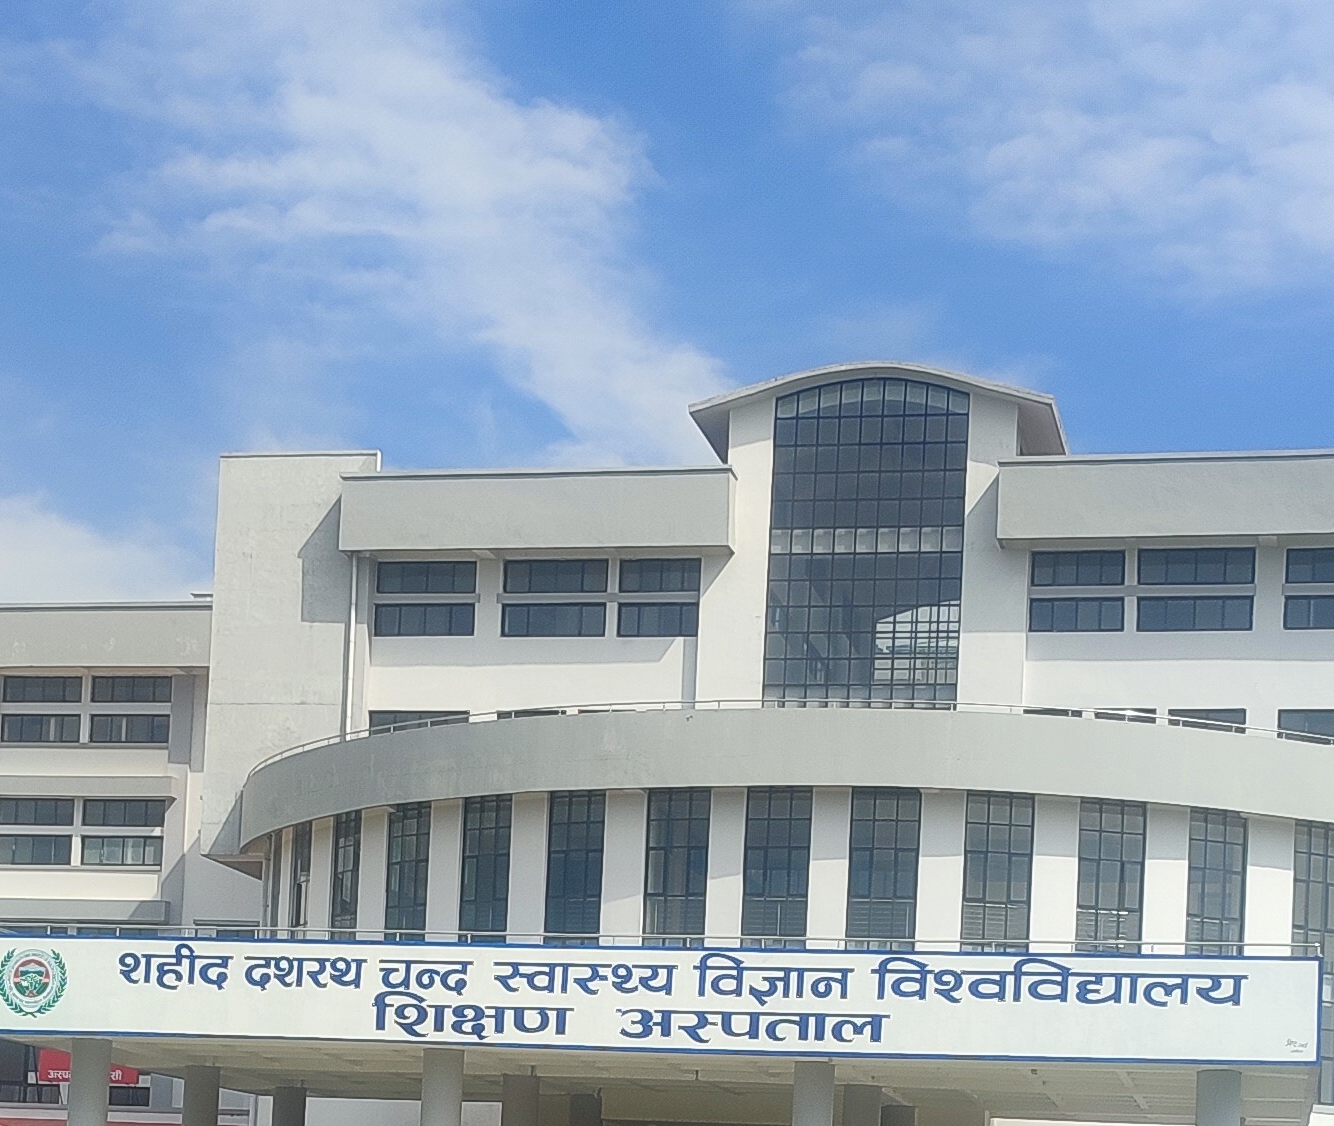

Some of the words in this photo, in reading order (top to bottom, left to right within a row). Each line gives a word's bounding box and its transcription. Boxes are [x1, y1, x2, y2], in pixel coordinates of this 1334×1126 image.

[119, 944, 234, 990] शहीद
[244, 956, 368, 991] दशरथ
[379, 960, 474, 995] चन्द
[493, 962, 677, 994] स्वास्थ्य
[693, 953, 855, 1005] विज्ञान
[871, 957, 1249, 1006] विश्वविद्यालय
[372, 991, 574, 1039] शिक्षण
[616, 1008, 891, 1043] अस्पताल
